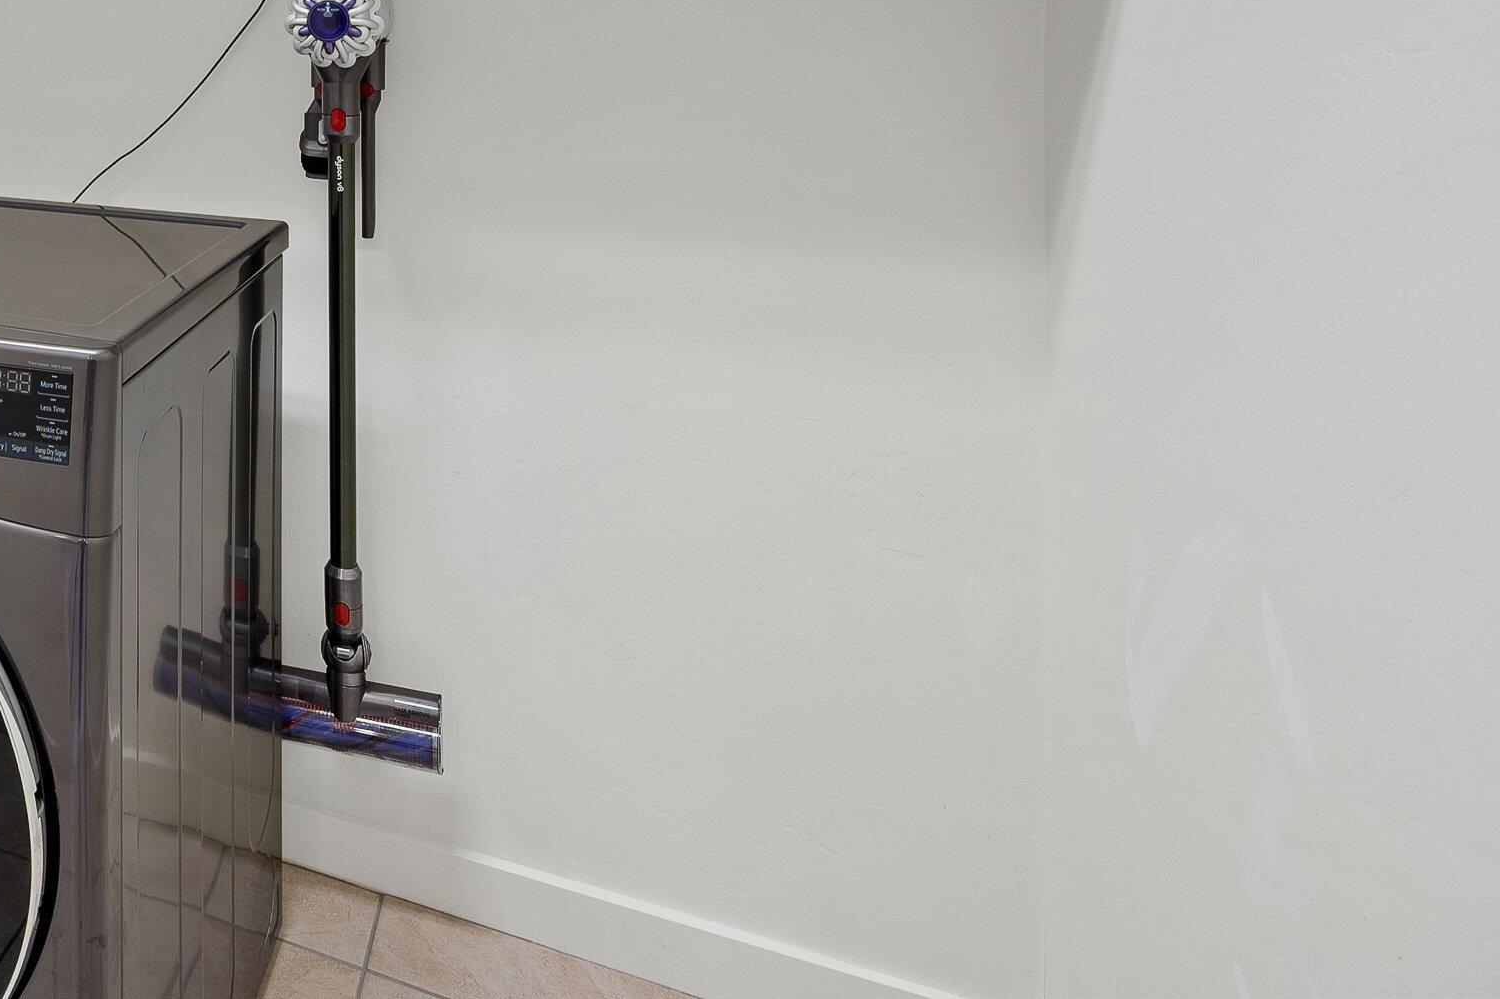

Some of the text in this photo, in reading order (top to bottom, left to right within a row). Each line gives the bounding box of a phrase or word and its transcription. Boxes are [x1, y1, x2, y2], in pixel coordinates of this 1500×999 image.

[335, 155, 344, 180] dyson
[53, 405, 66, 413] Time
[56, 427, 68, 436] Care
[12, 444, 27, 453] Signal
[46, 448, 54, 456] Dry
